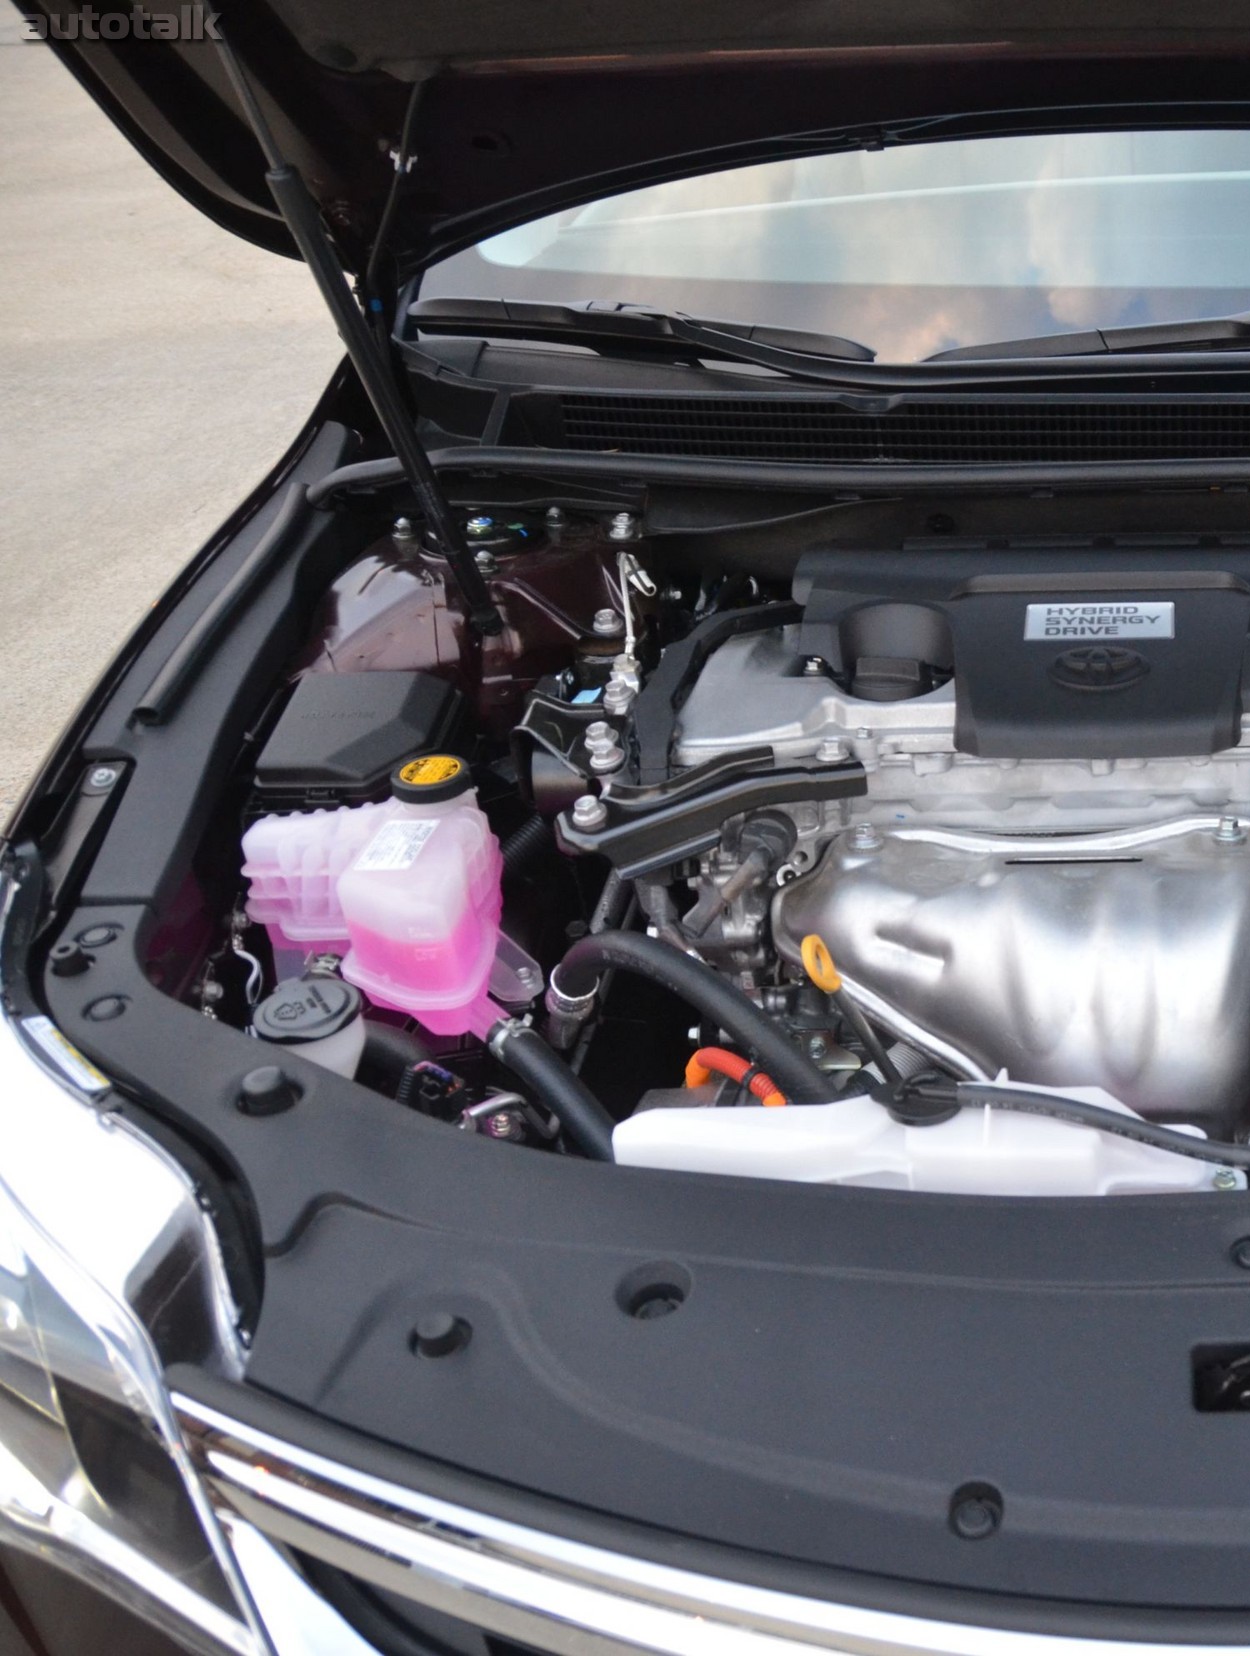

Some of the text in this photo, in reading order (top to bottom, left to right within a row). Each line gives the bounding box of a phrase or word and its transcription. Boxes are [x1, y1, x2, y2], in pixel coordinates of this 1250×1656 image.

[1047, 606, 1139, 615] HYBRID
[1045, 615, 1160, 626] SYNERGY
[1044, 626, 1119, 636] DRIVE
